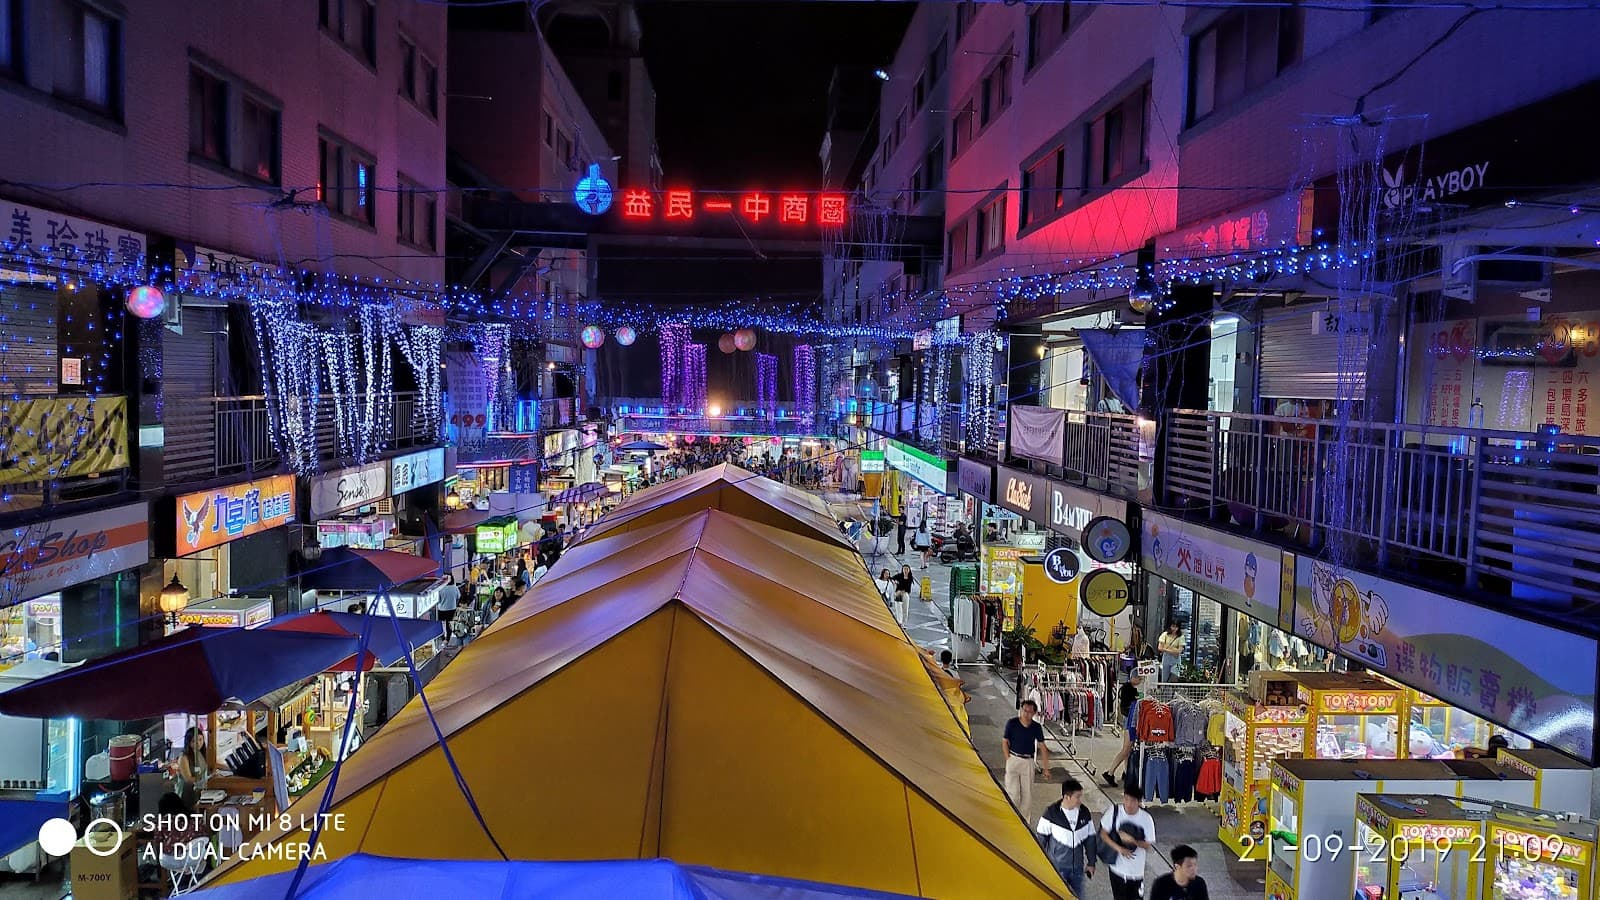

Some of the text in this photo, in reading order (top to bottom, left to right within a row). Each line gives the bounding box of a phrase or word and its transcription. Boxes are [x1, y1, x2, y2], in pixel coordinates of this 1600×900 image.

[625, 190, 844, 224] 益民一中商圈
[1324, 694, 1394, 708] TOY STORY
[1402, 825, 1473, 839] TOY STORY
[78, 873, 112, 882] M-700Y
